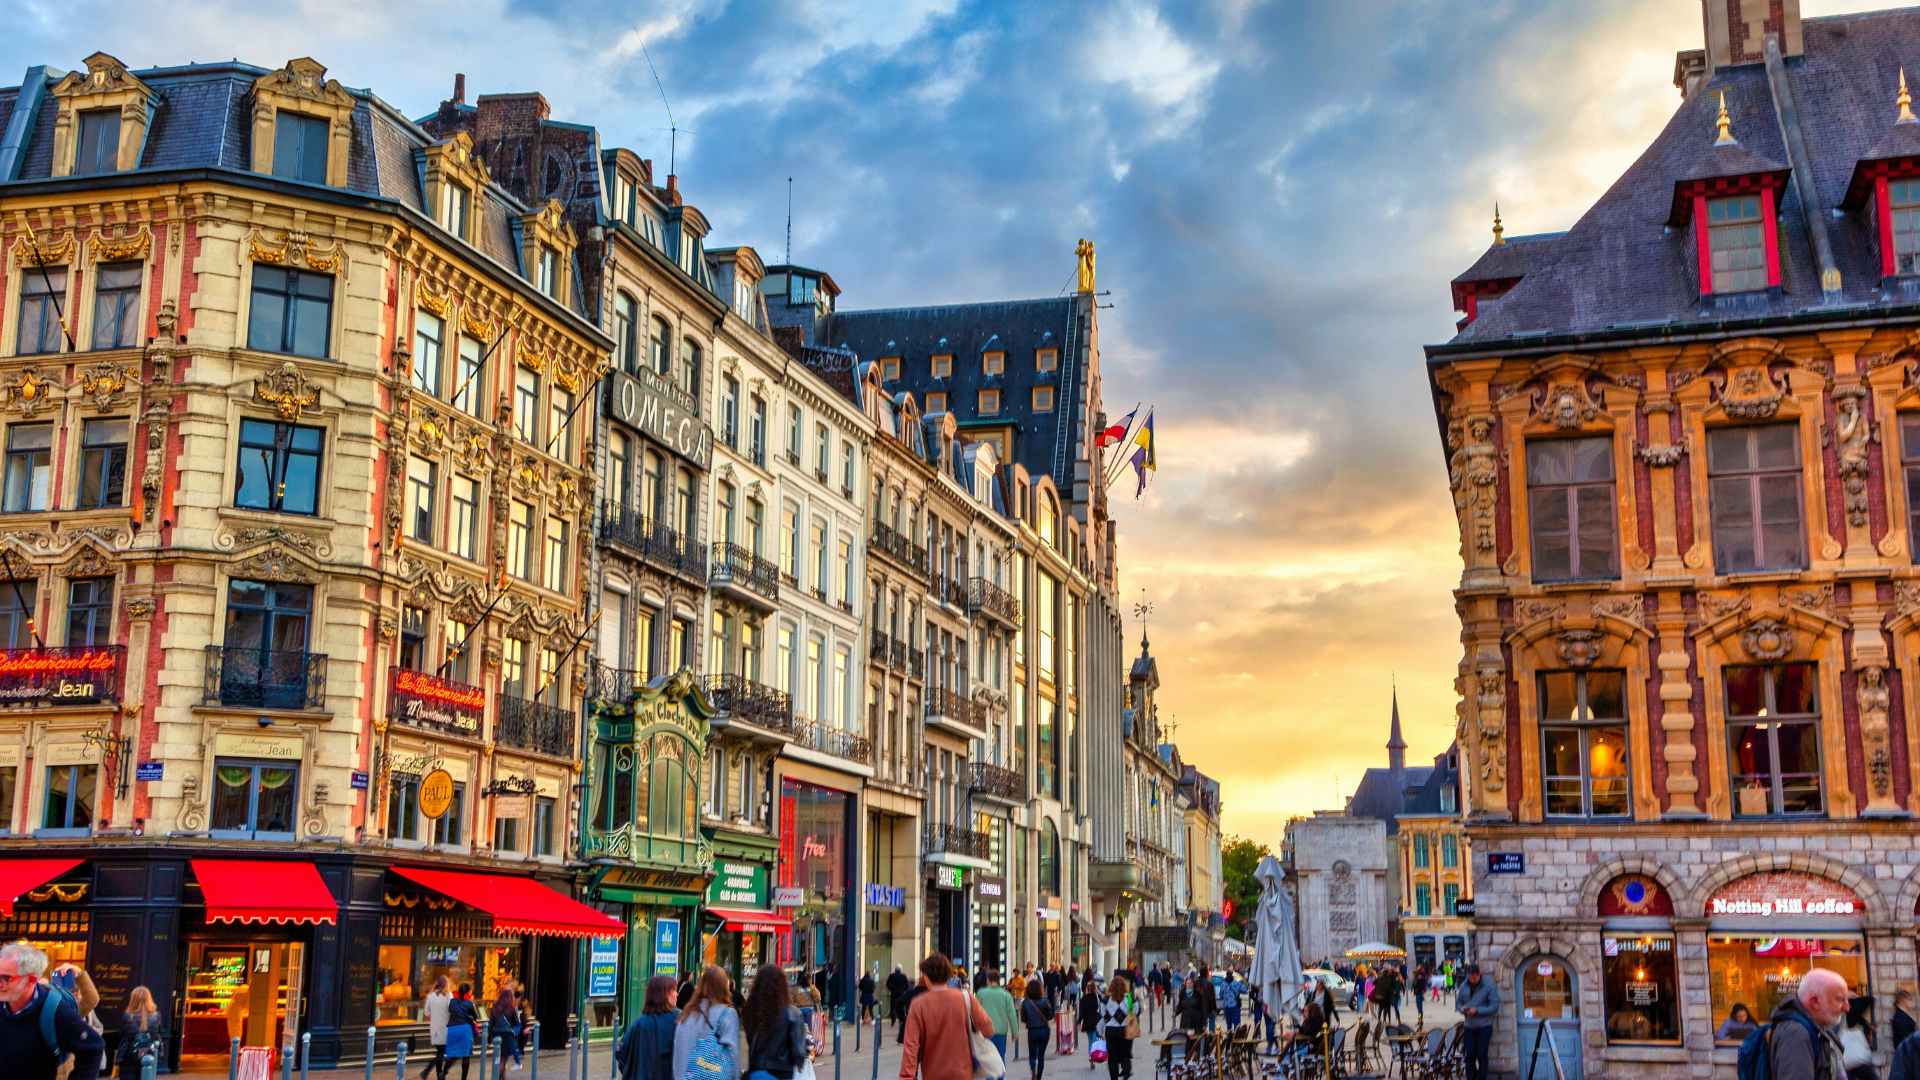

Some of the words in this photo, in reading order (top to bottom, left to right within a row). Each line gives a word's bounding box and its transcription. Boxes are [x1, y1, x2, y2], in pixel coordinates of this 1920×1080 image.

[621, 379, 706, 465] OMEGA
[53, 679, 94, 697] Jean
[453, 710, 477, 731] Jean
[656, 700, 685, 726] Cloche
[423, 783, 450, 801] PAUL
[802, 836, 826, 861] free
[1713, 898, 1772, 915] Notting
[1776, 898, 1803, 913] Hill
[1806, 898, 1854, 914] coffee
[1617, 939, 1649, 953] otting
